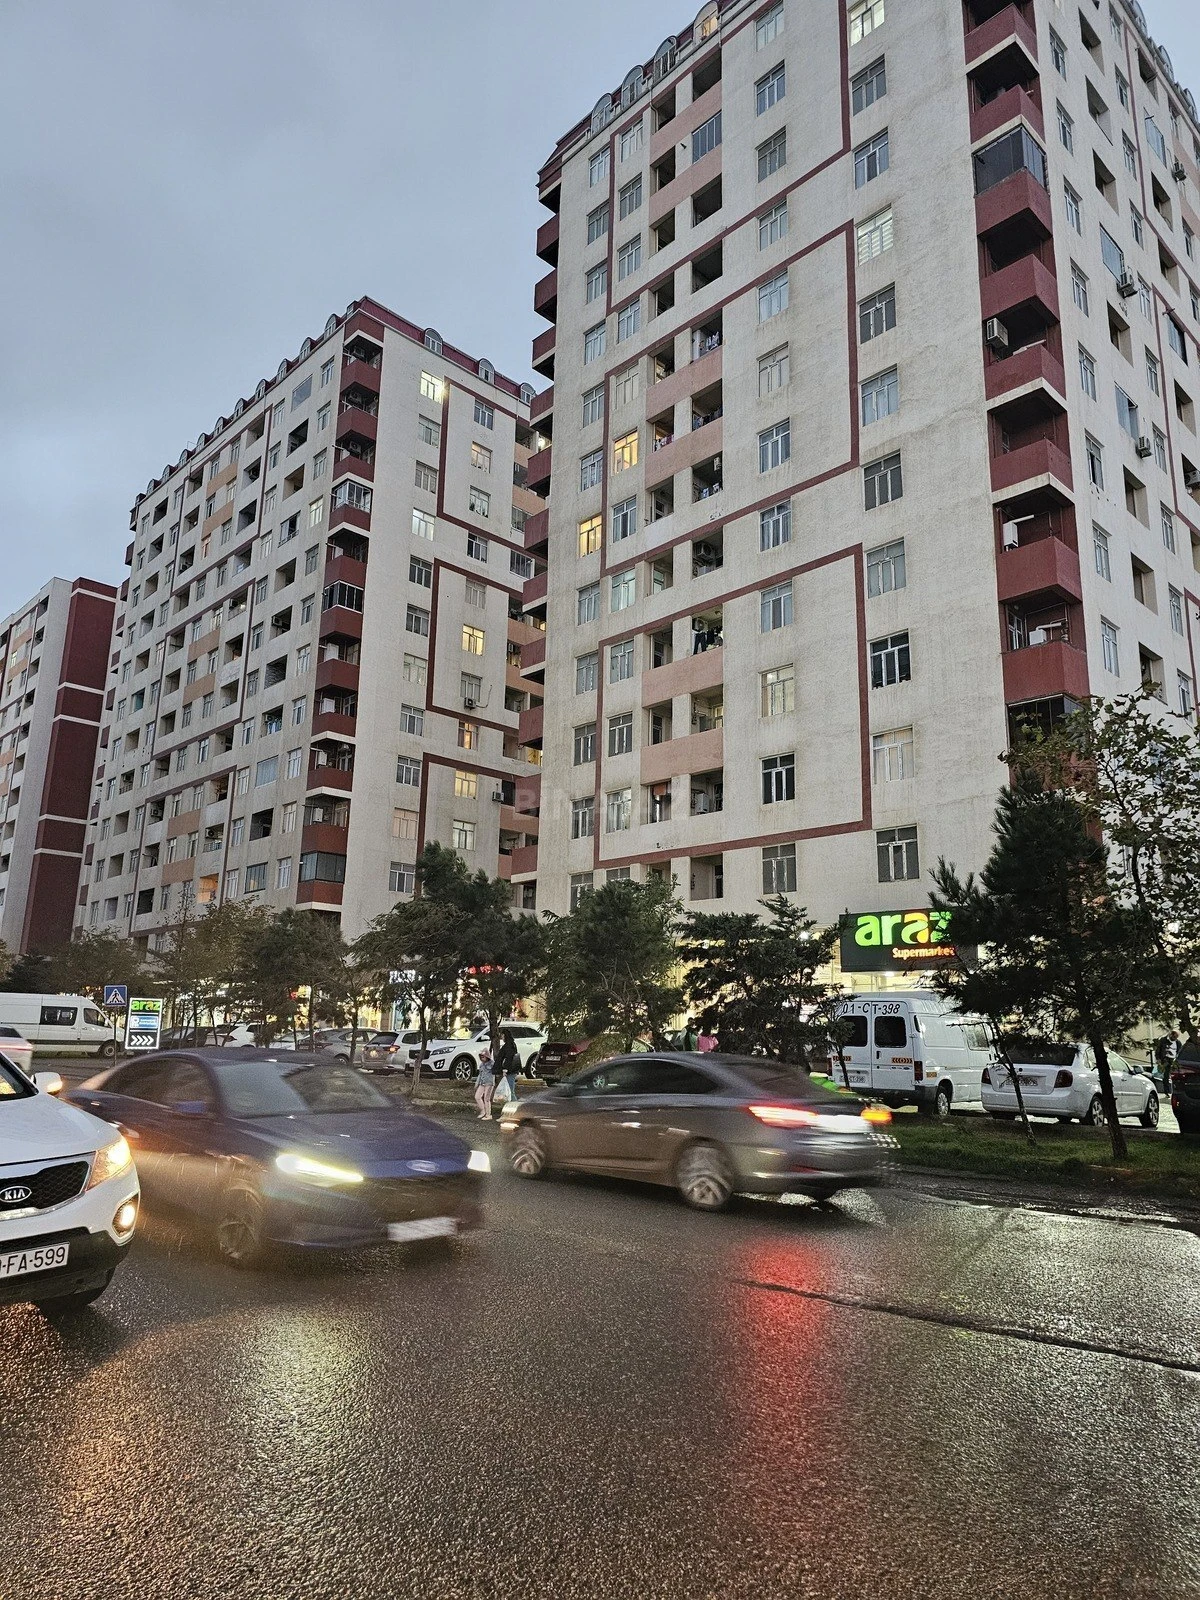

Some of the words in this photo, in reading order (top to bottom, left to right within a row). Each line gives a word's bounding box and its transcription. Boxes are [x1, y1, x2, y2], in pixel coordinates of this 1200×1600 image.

[855, 911, 953, 946] araz
[131, 1000, 161, 1011] araz
[4, 1189, 26, 1200] KIA
